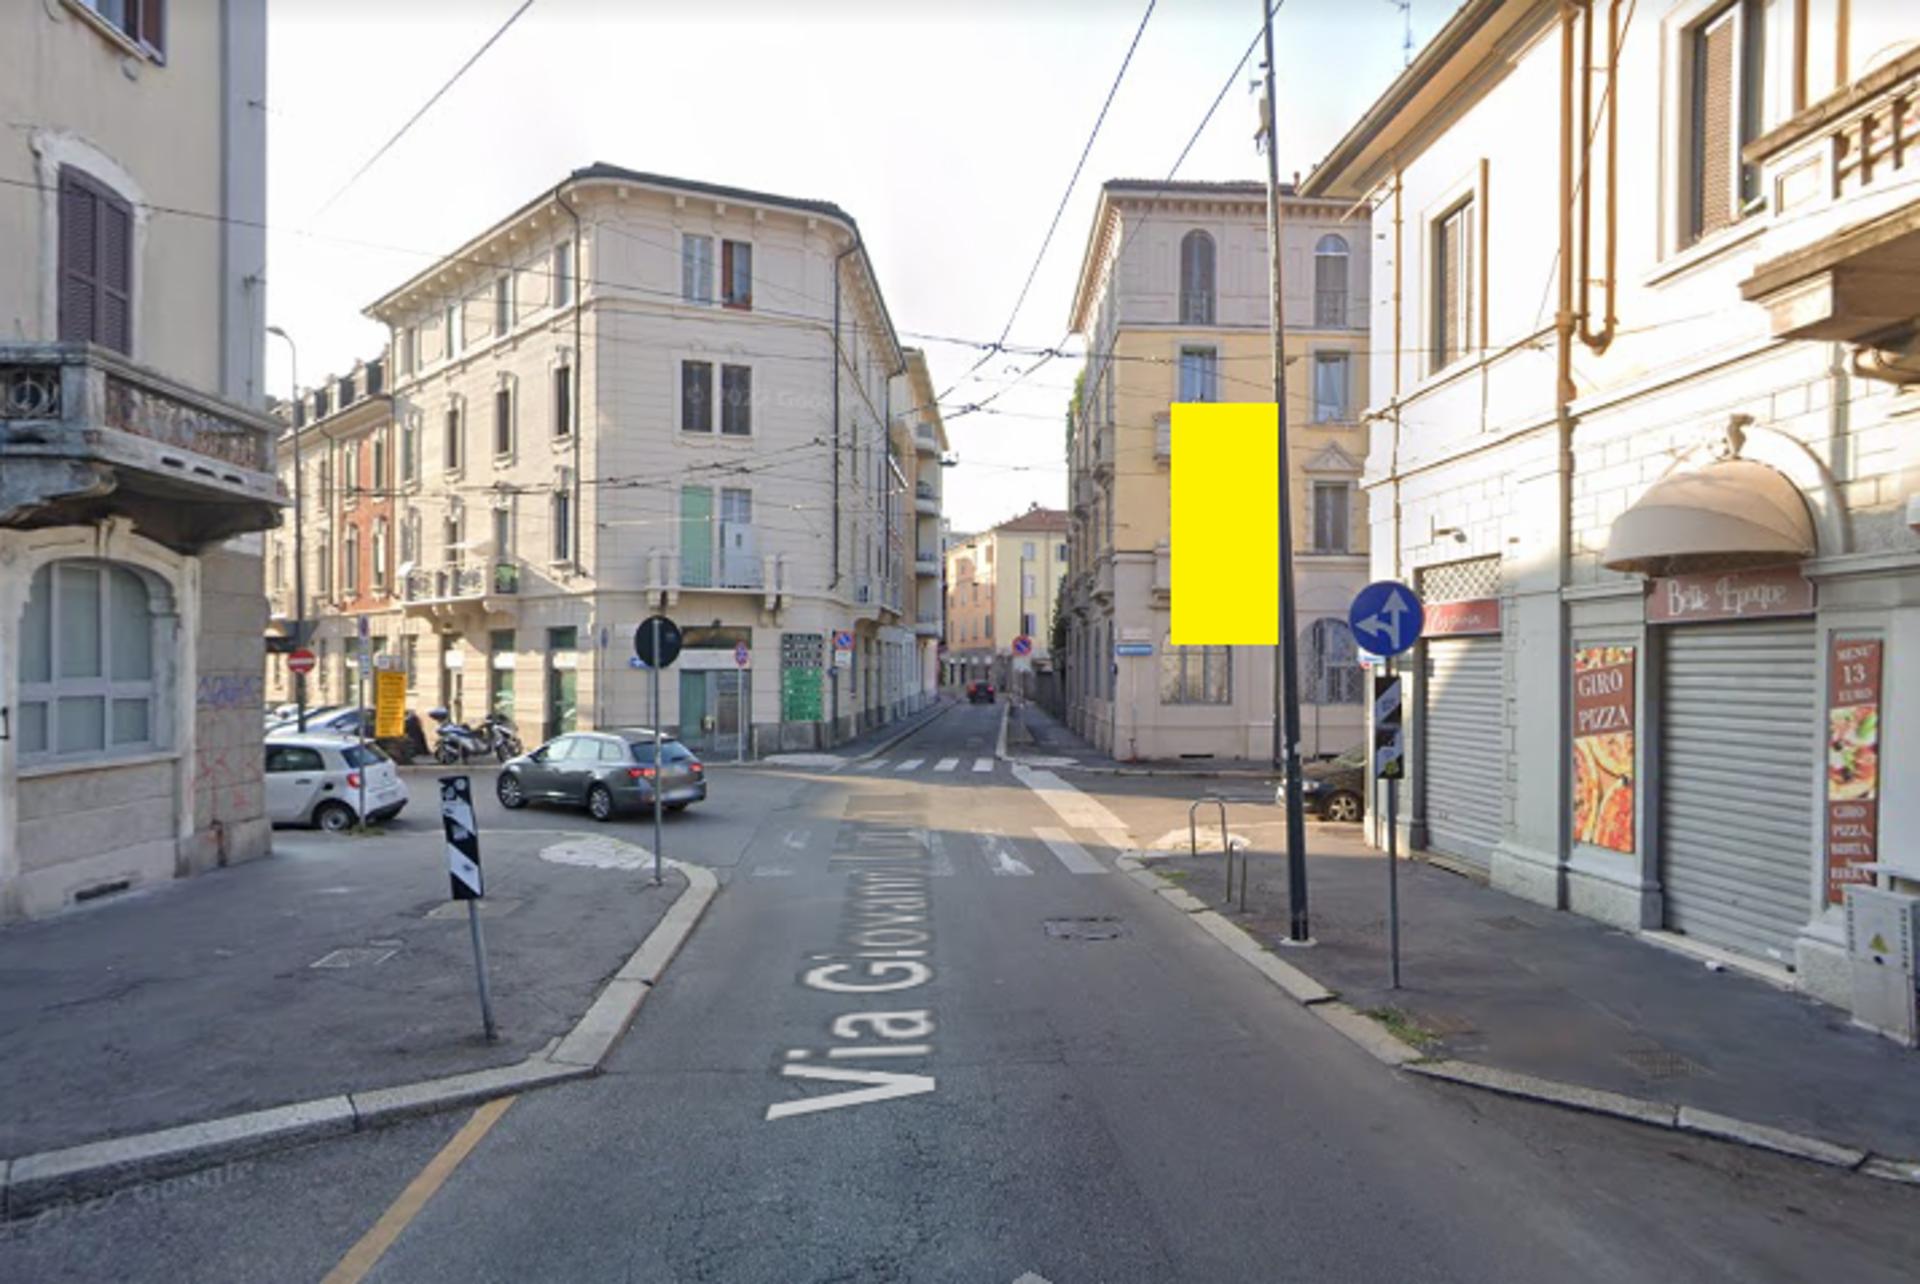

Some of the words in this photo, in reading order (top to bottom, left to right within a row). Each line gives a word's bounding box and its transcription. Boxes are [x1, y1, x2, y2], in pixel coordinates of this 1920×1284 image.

[1578, 668, 1624, 697] GIRO
[1843, 663, 1867, 685] 13
[1578, 703, 1630, 731] PIZZA
